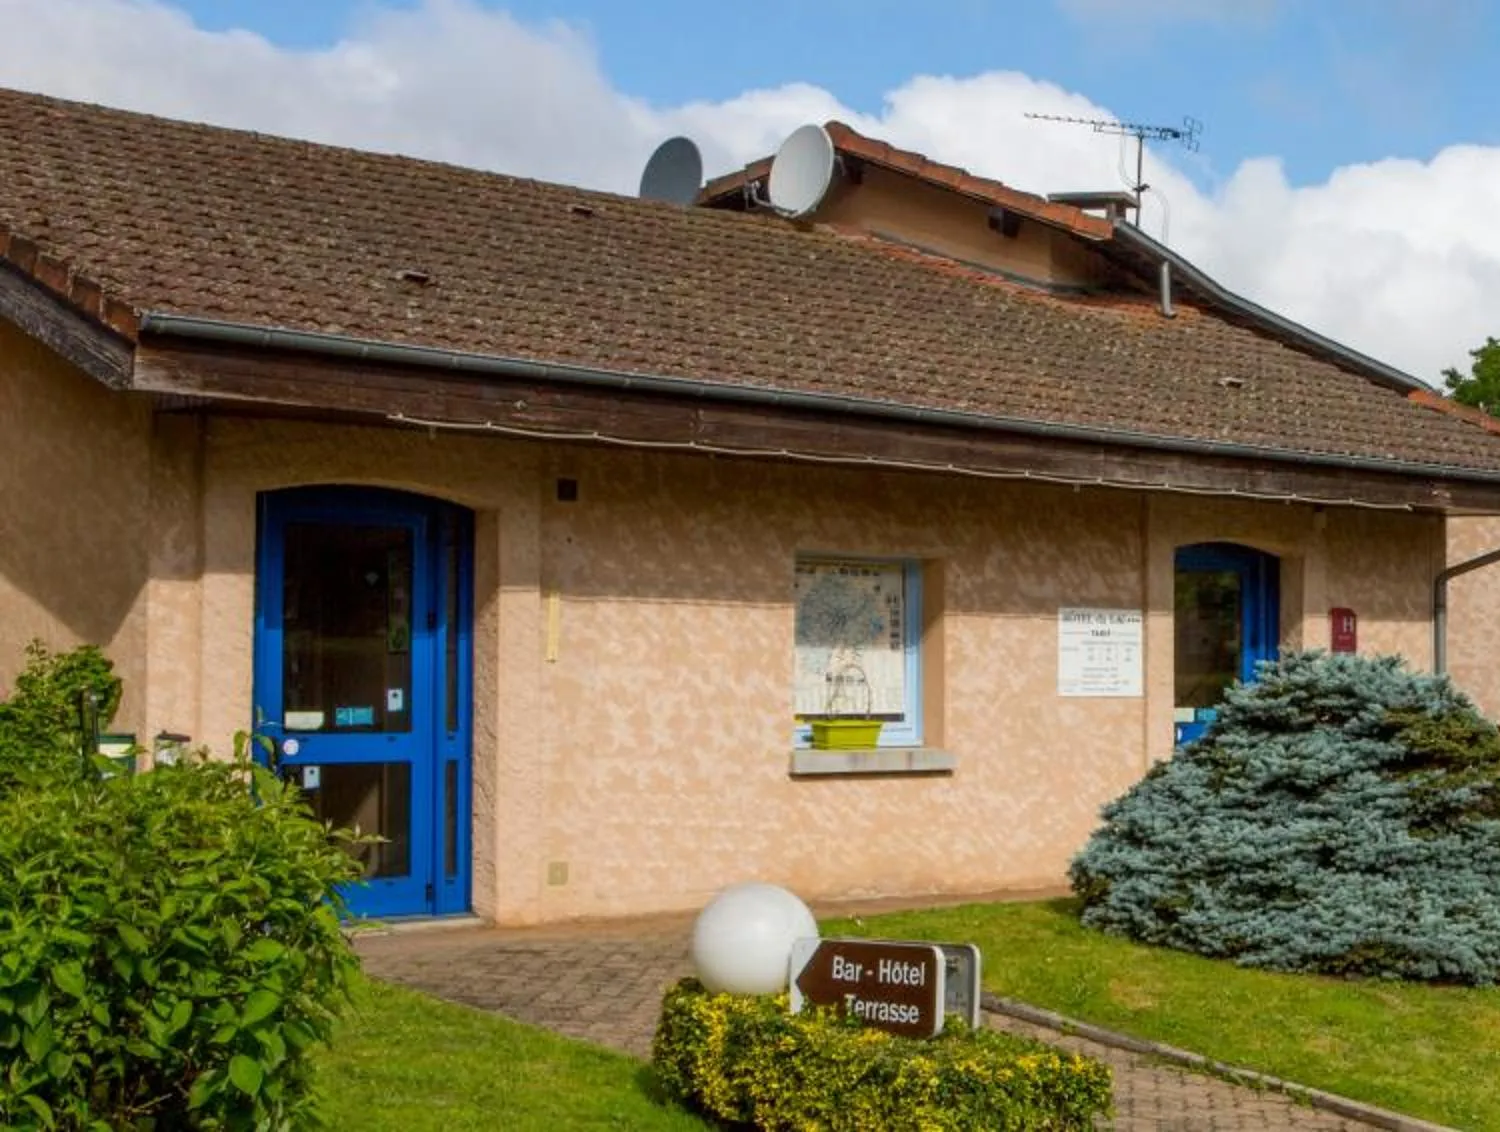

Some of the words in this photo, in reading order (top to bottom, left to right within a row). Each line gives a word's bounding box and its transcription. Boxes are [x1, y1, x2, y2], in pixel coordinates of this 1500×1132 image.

[1343, 615, 1353, 632] H
[832, 956, 863, 982] Bar
[879, 959, 926, 986] Hôtel
[844, 994, 919, 1024] Terrasse
